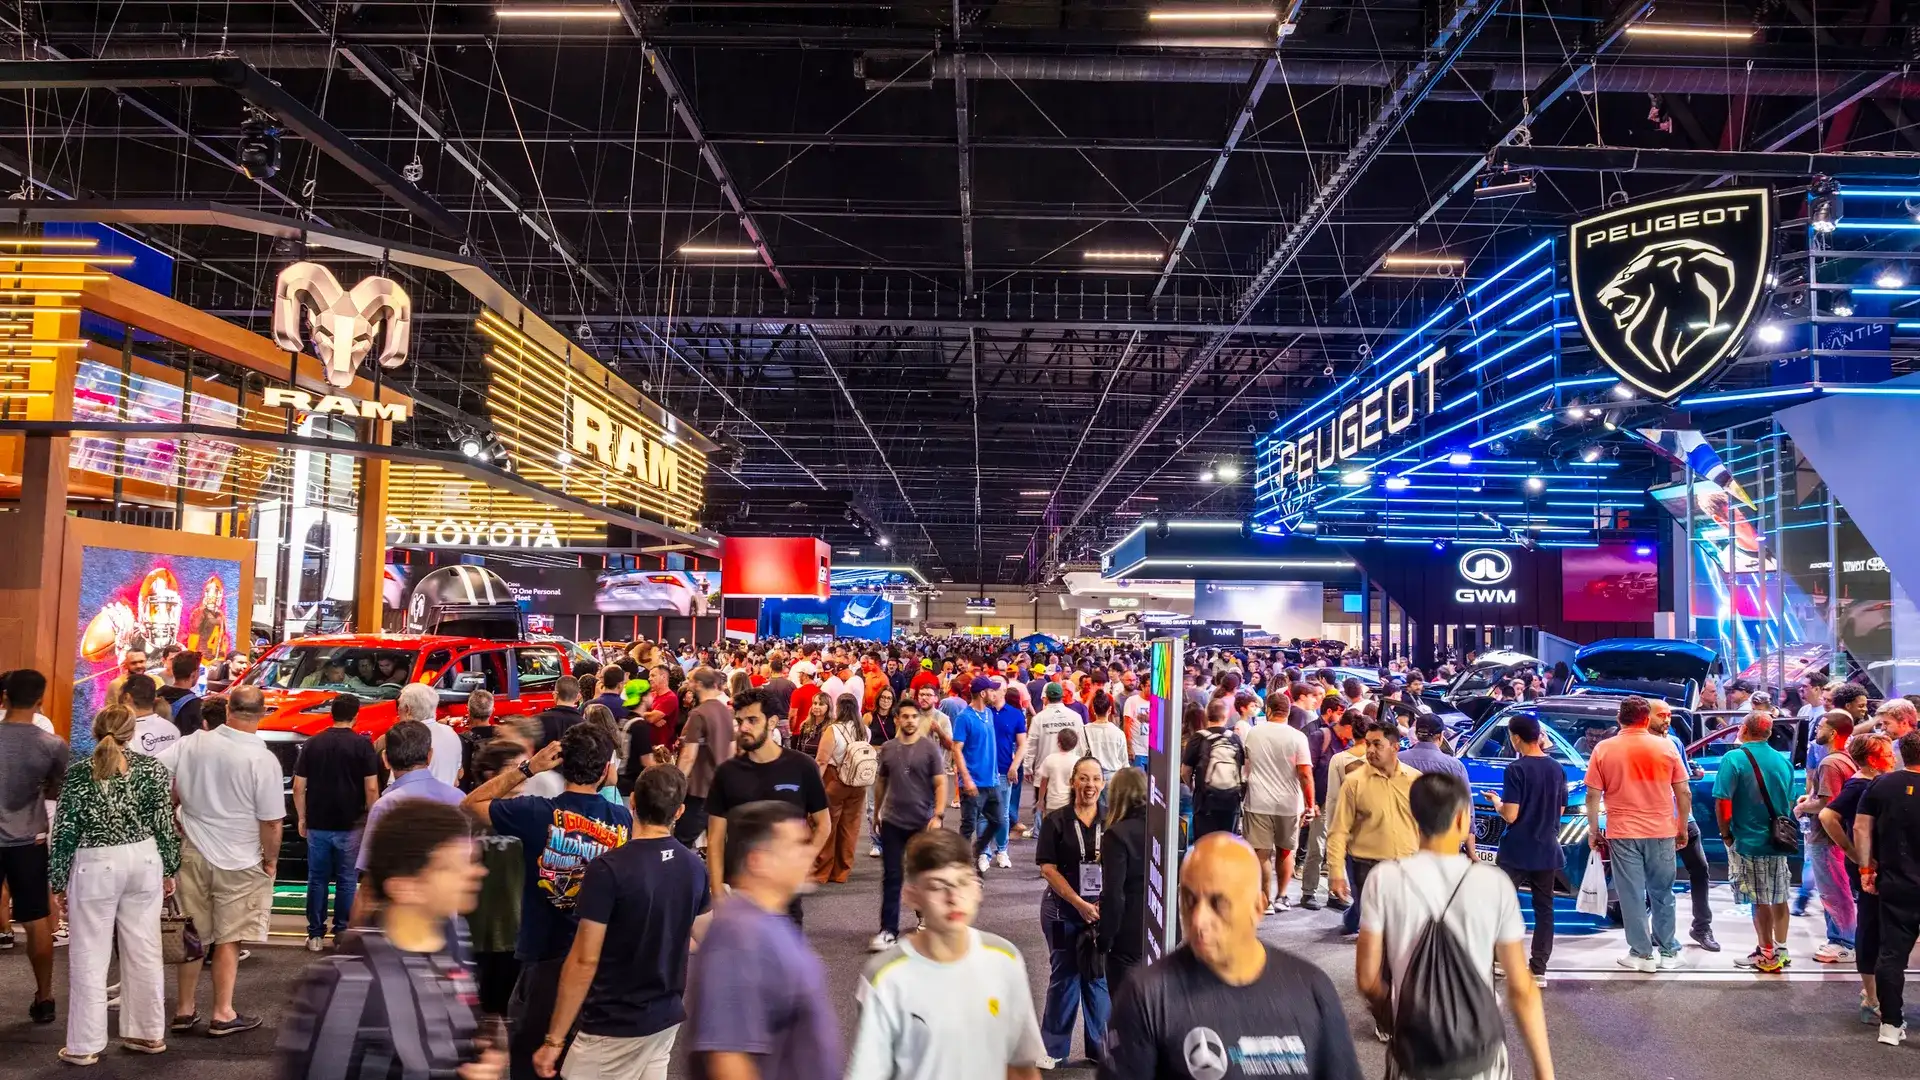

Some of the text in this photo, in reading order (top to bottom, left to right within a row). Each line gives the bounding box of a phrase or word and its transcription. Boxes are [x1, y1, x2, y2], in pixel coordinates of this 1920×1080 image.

[1587, 206, 1749, 248] PEUGEOT
[1779, 323, 1883, 367] SLANTIS
[263, 387, 407, 422] RAM
[1281, 347, 1447, 488] PEUGEOT
[573, 394, 678, 493] RAM
[413, 516, 562, 548] TOYOTA
[533, 588, 561, 596] Personal
[1455, 588, 1516, 604] GWM
[1212, 628, 1236, 636] TANK
